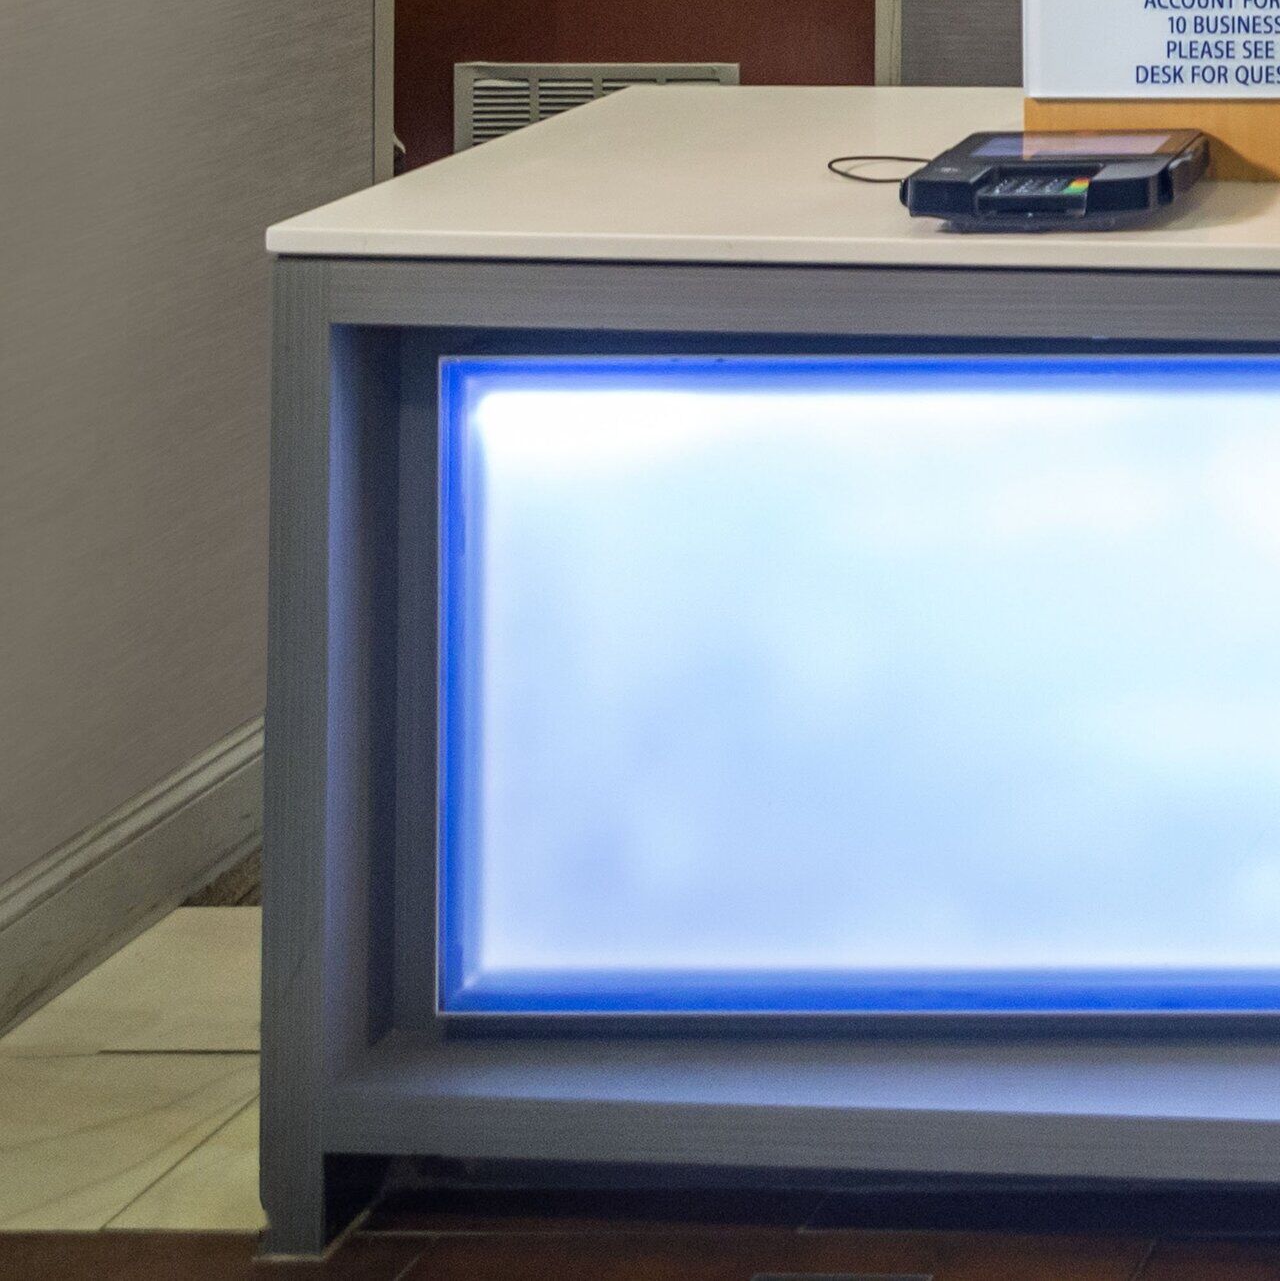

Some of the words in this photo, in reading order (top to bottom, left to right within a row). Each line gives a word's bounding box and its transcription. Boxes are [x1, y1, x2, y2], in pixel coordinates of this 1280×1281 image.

[1168, 16, 1187, 34] 10
[1167, 40, 1235, 59] PLEASE
[1243, 40, 1275, 59] SEE
[1135, 66, 1184, 84] DESK
[1191, 66, 1228, 84] FOR
